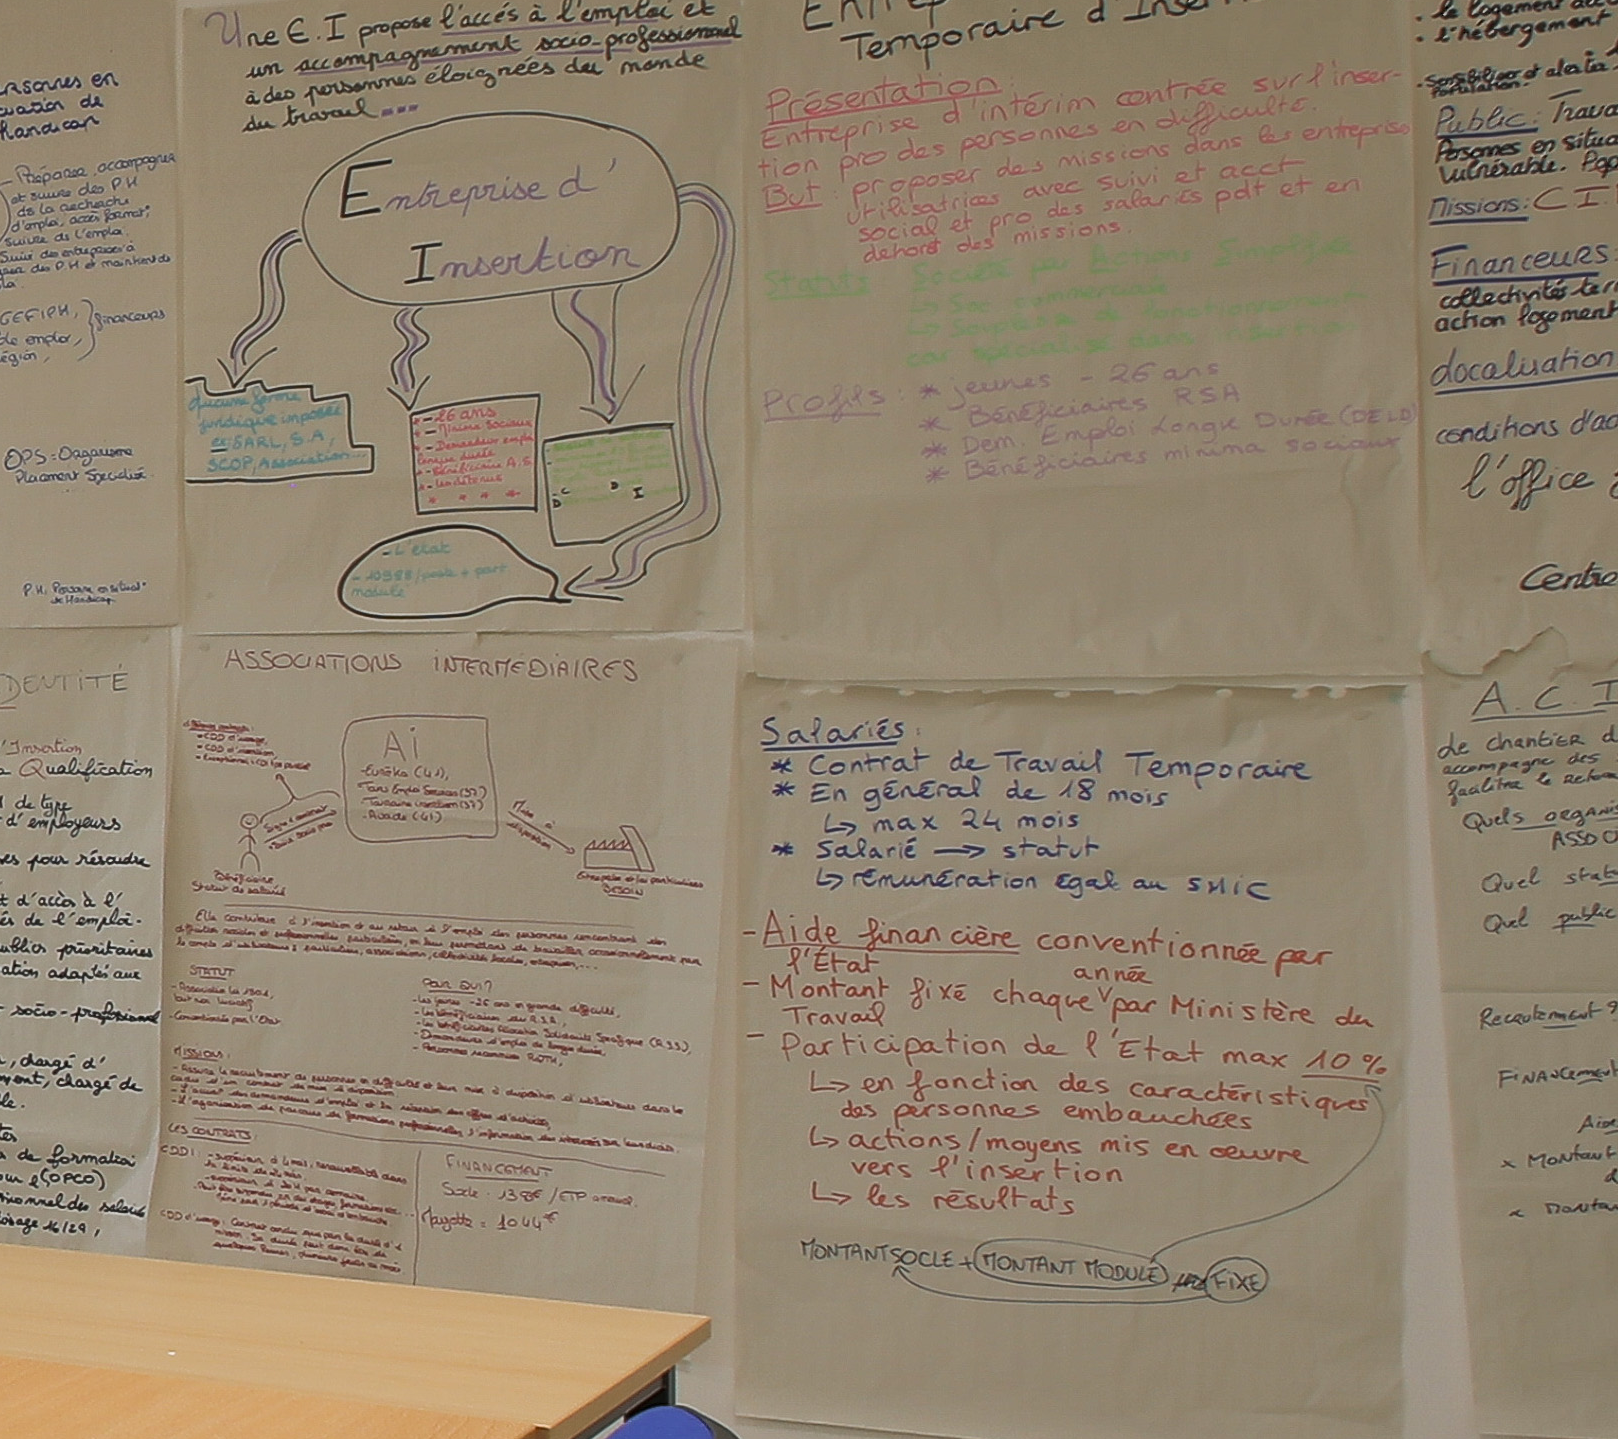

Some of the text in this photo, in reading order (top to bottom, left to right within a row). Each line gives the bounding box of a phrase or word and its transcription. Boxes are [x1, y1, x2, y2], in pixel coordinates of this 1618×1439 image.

[204, 10, 281, 49] Une
[359, 17, 433, 47] propose
[529, 4, 547, 22] à
[684, 0, 715, 18] et
[840, 6, 1065, 70] Temporaire
[1435, 12, 1611, 48] l'hébergement
[246, 62, 284, 80] un
[294, 37, 522, 77] accompagnement
[90, 71, 119, 89] en
[245, 52, 710, 107] à des personnes éloignées du monde
[79, 93, 104, 110] de
[242, 100, 377, 132] du travail
[761, 117, 920, 150] Entreprise
[943, 91, 1096, 125] d'intérim
[1117, 81, 1227, 109] centrée
[1253, 74, 1303, 94] sur
[760, 159, 819, 178] tion
[839, 151, 887, 185] pro
[897, 141, 944, 163] des
[959, 122, 1099, 159] personnes
[1111, 119, 1146, 134] en
[340, 159, 547, 219] Entreprise
[404, 235, 639, 285] Insertion
[948, 373, 1051, 411] jeunes
[1164, 362, 1219, 381] ans
[1175, 385, 1240, 405] RSA
[461, 407, 496, 421] ans
[1435, 415, 1559, 444] conditions
[1462, 452, 1595, 511] l'office
[224, 650, 403, 674] ASSOCIATIONS
[762, 717, 905, 745] Salariés
[19, 758, 154, 781] Qualification
[809, 749, 1311, 788] Contrat de Travail Temporaire
[14, 796, 34, 811] de
[40, 794, 73, 816] type
[810, 775, 1168, 811] En général de 18 mois
[872, 810, 1079, 832] max 24 mois
[1463, 808, 1525, 832] Quels
[816, 836, 1098, 860] Salarié statut
[1482, 867, 1540, 893] Quel
[1484, 907, 1530, 933] Quel
[762, 910, 1332, 977] Aide financière conventionnée par
[1073, 965, 1153, 985] année
[770, 975, 1375, 1028] Montant fixé chaque par Ministère du
[782, 1004, 885, 1026] Travail
[781, 1030, 1007, 1060] Participation
[1024, 1033, 1068, 1055] de
[1222, 1048, 1285, 1069] max
[1306, 1051, 1351, 1071] 10
[862, 1072, 1370, 1119] en fonction des caractéristiques
[801, 1238, 889, 1264] MONTANT
[891, 1246, 953, 1269] SOCLE
[983, 1251, 1076, 1276] MONTANT
